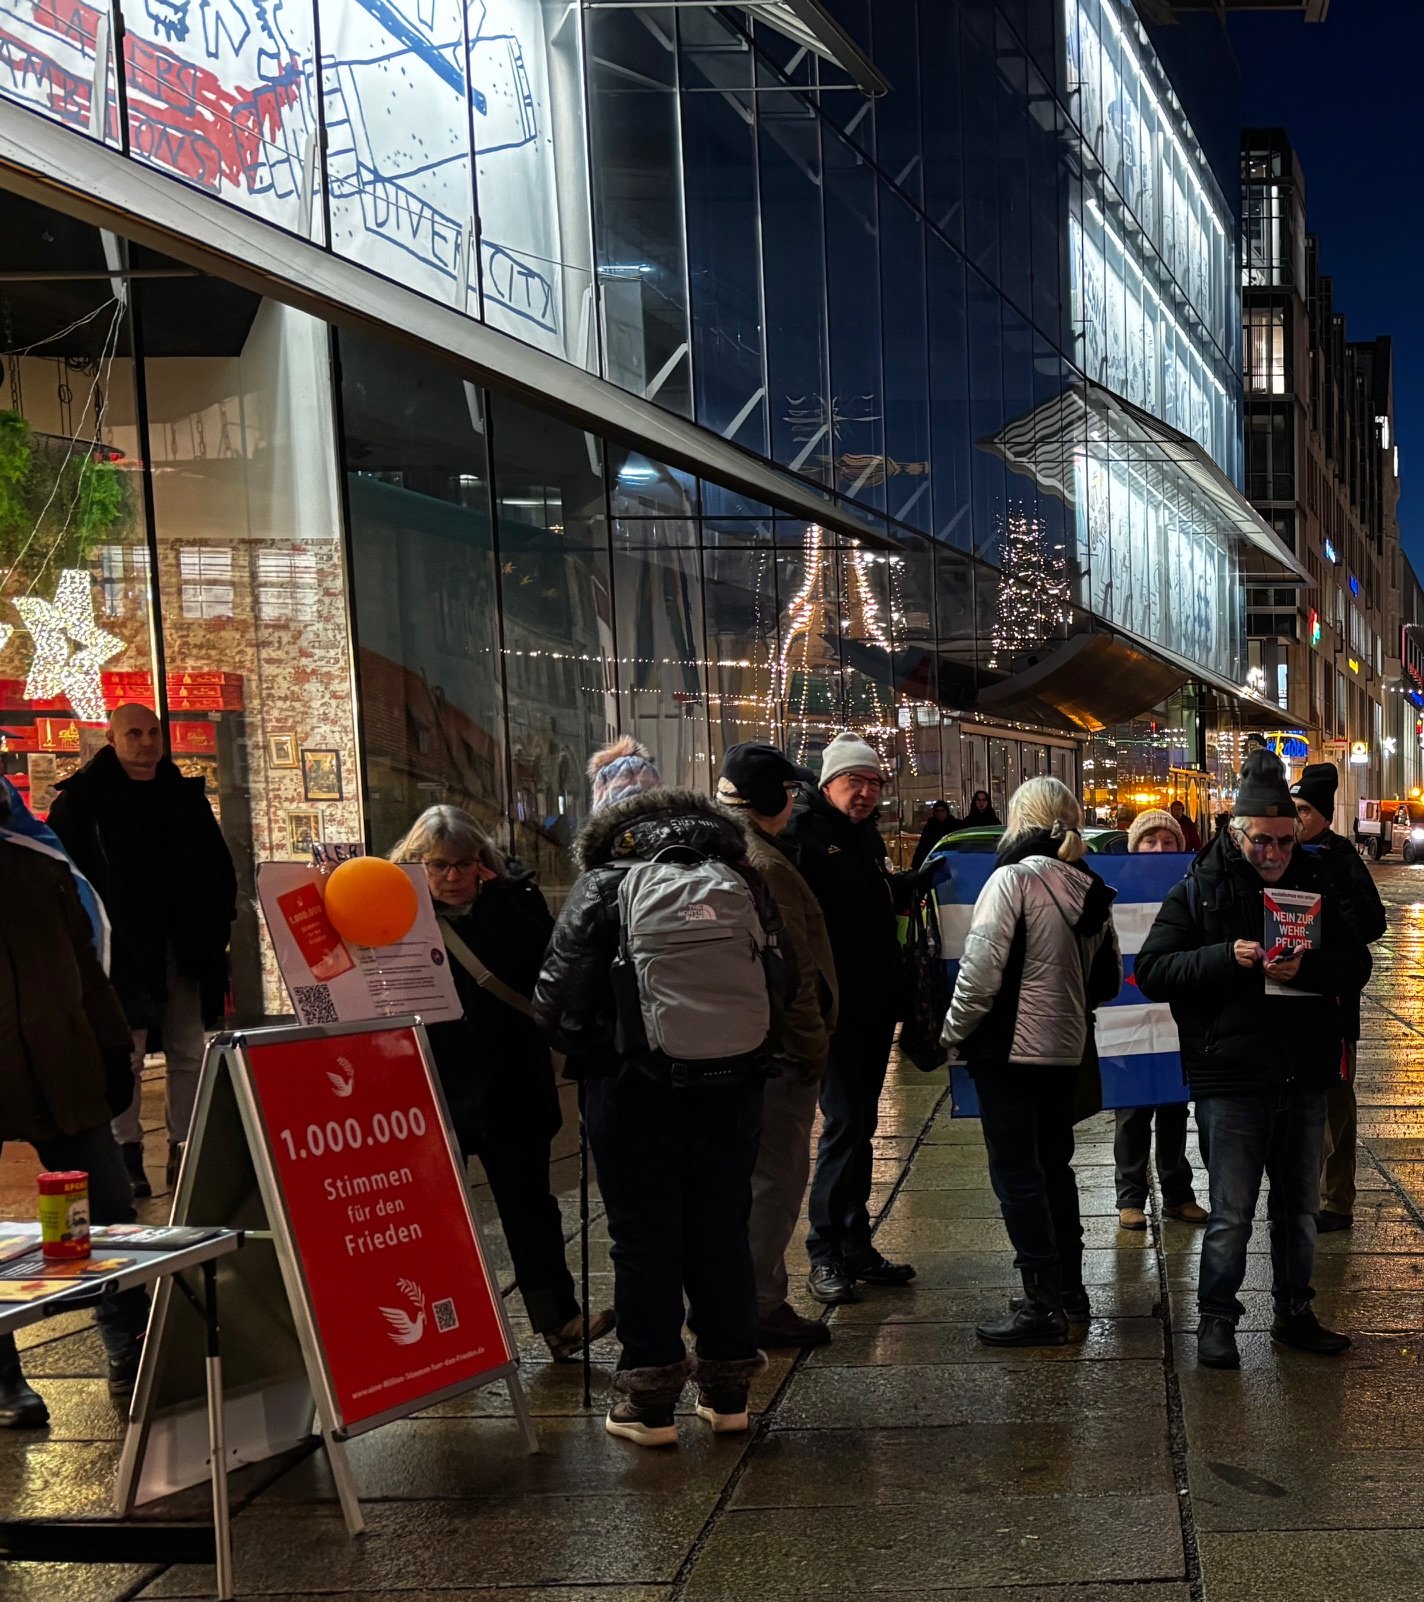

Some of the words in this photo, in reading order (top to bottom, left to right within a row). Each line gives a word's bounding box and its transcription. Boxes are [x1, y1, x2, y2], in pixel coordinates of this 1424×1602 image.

[1273, 911, 1296, 924] NEIN
[1297, 913, 1314, 925] ZUR
[1275, 937, 1313, 949] PFLICHT
[1279, 925, 1310, 937] WEHR-
[280, 1107, 426, 1161] 1.000.000
[324, 1167, 413, 1200] Stimmen
[348, 1205, 371, 1224] für
[376, 1199, 405, 1216] den
[344, 1223, 423, 1256] Frieden
